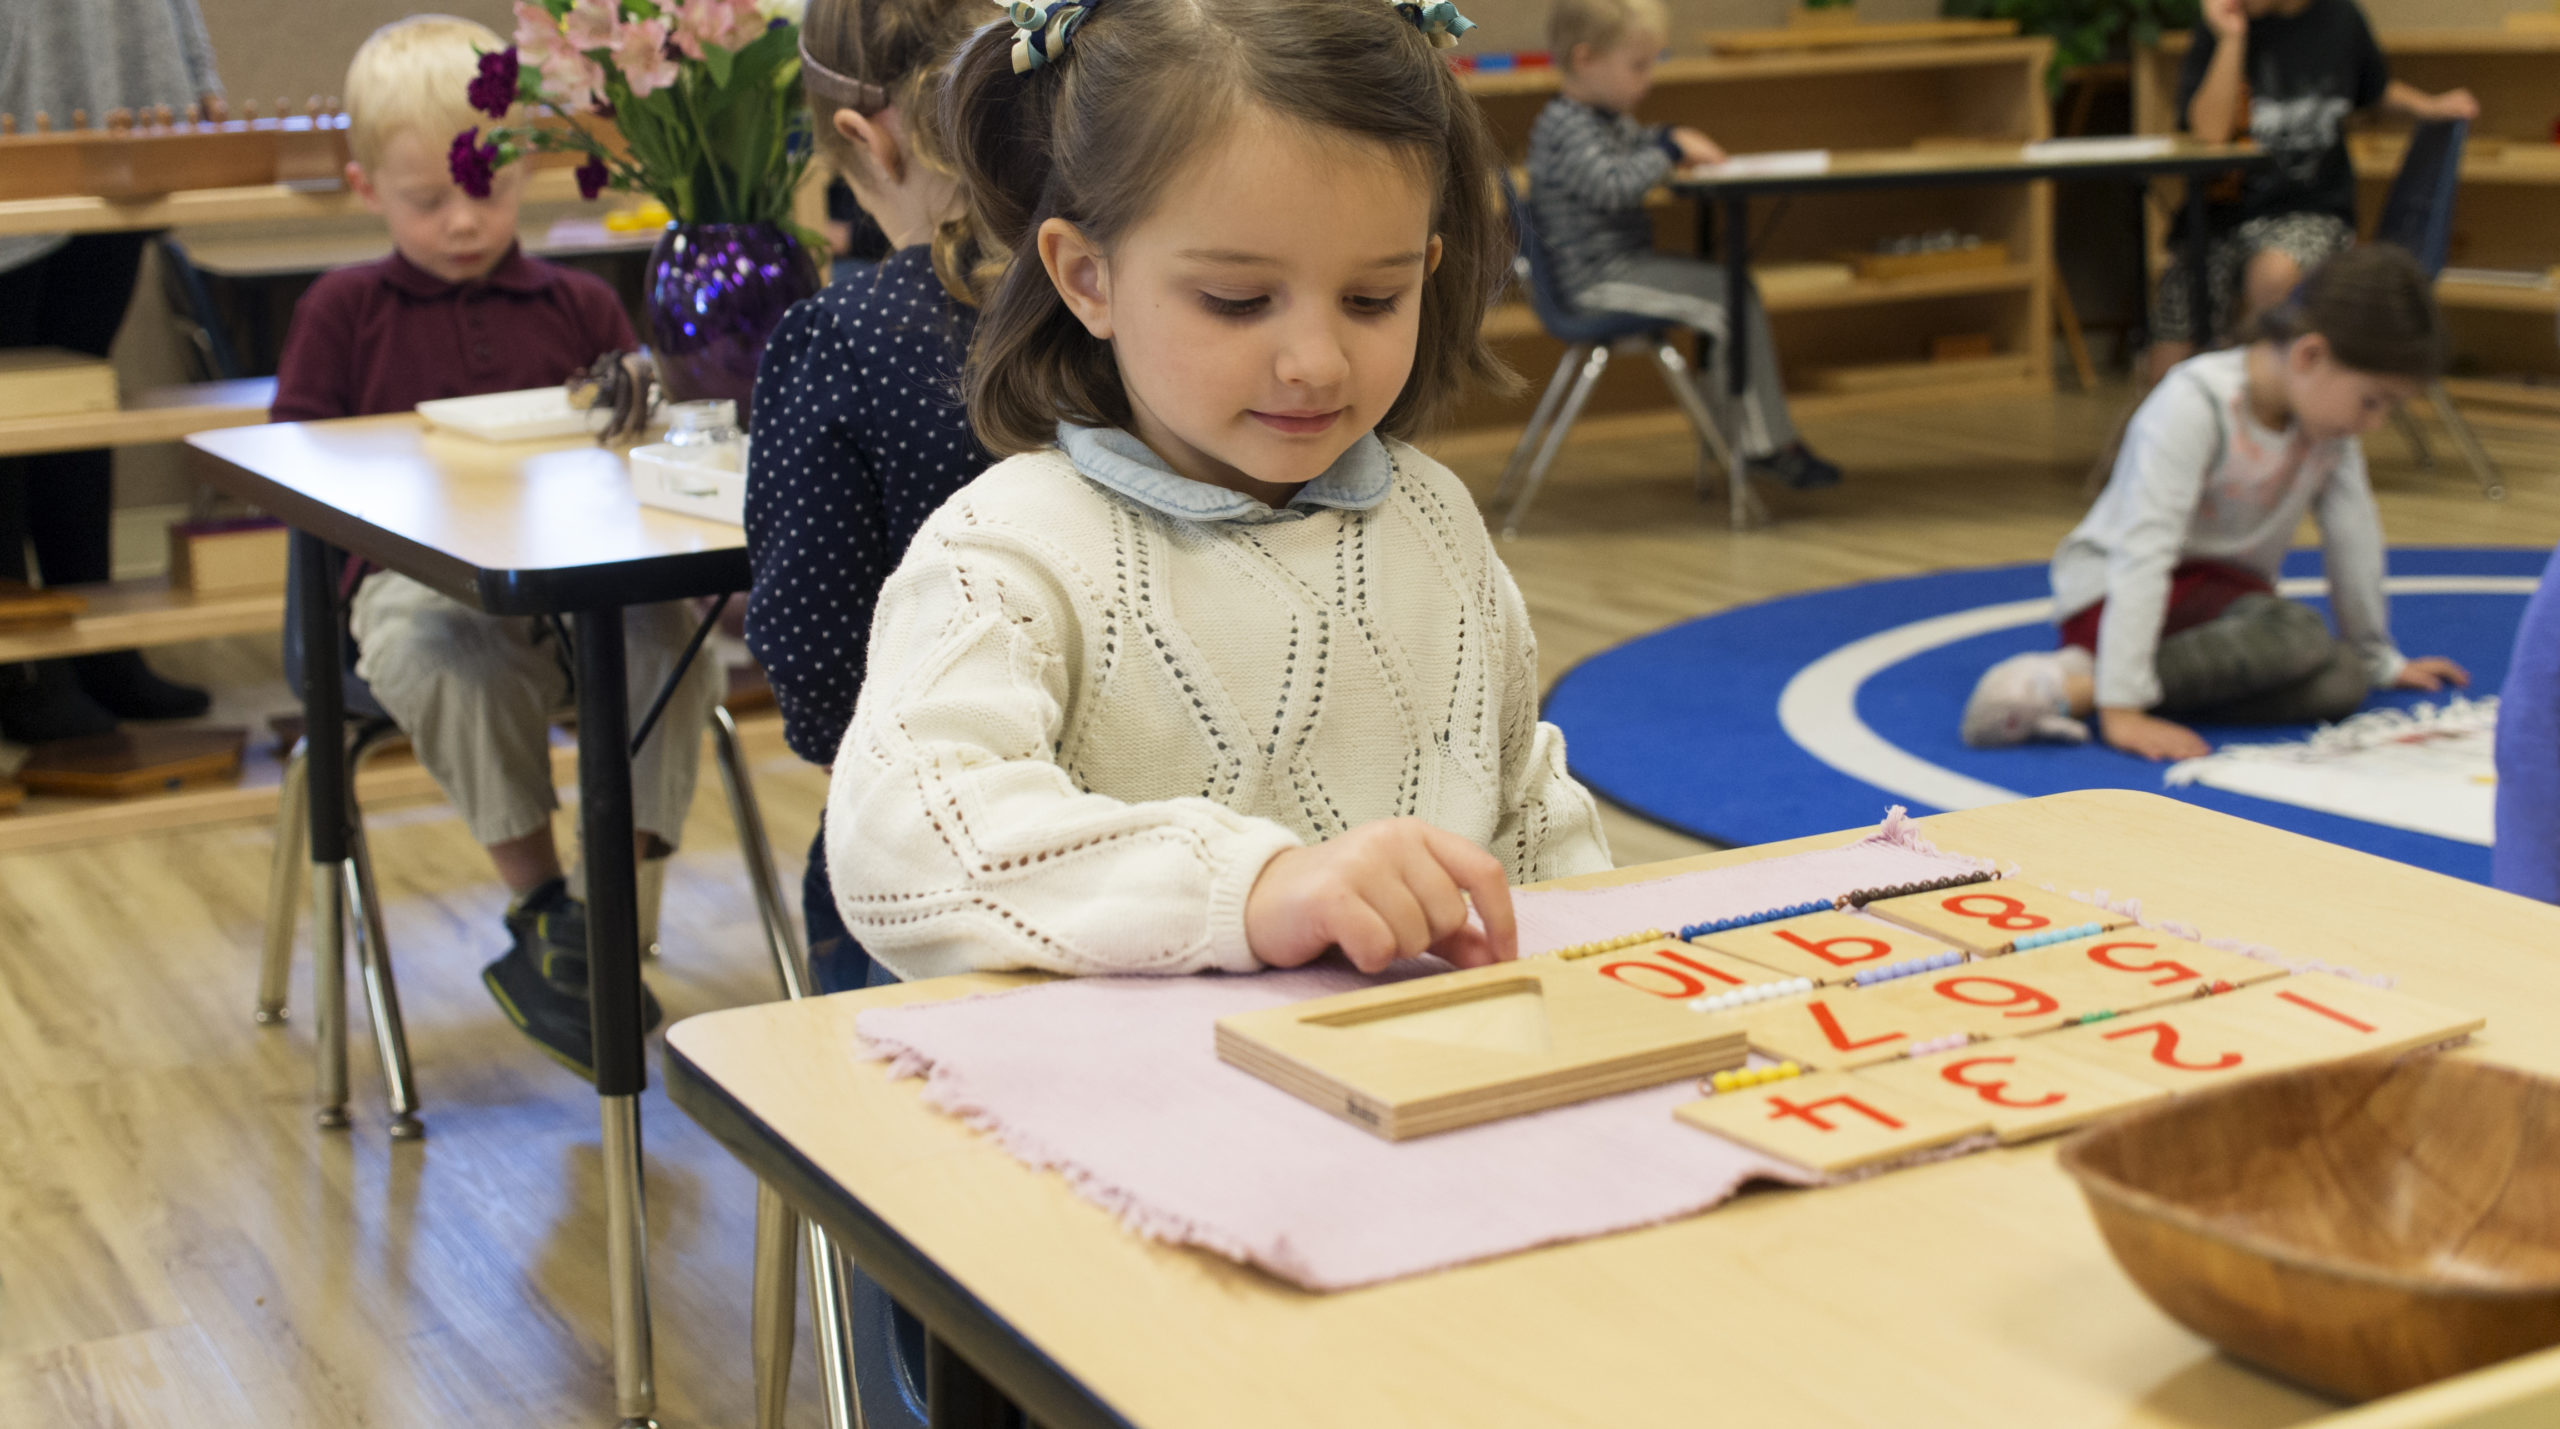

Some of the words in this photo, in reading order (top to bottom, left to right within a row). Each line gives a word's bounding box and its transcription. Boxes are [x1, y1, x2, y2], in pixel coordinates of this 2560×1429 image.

[1941, 894, 2050, 930] 8
[1773, 930, 1892, 966] 9
[2087, 942, 2200, 986] 5
[1599, 950, 1745, 999] 10
[1933, 977, 2060, 1018] 6
[2277, 991, 2377, 1033] 1
[1808, 1001, 1907, 1052] 7
[2103, 1022, 2243, 1071] 2
[1940, 1058, 2067, 1108] 3
[1767, 1095, 1906, 1132] 4
